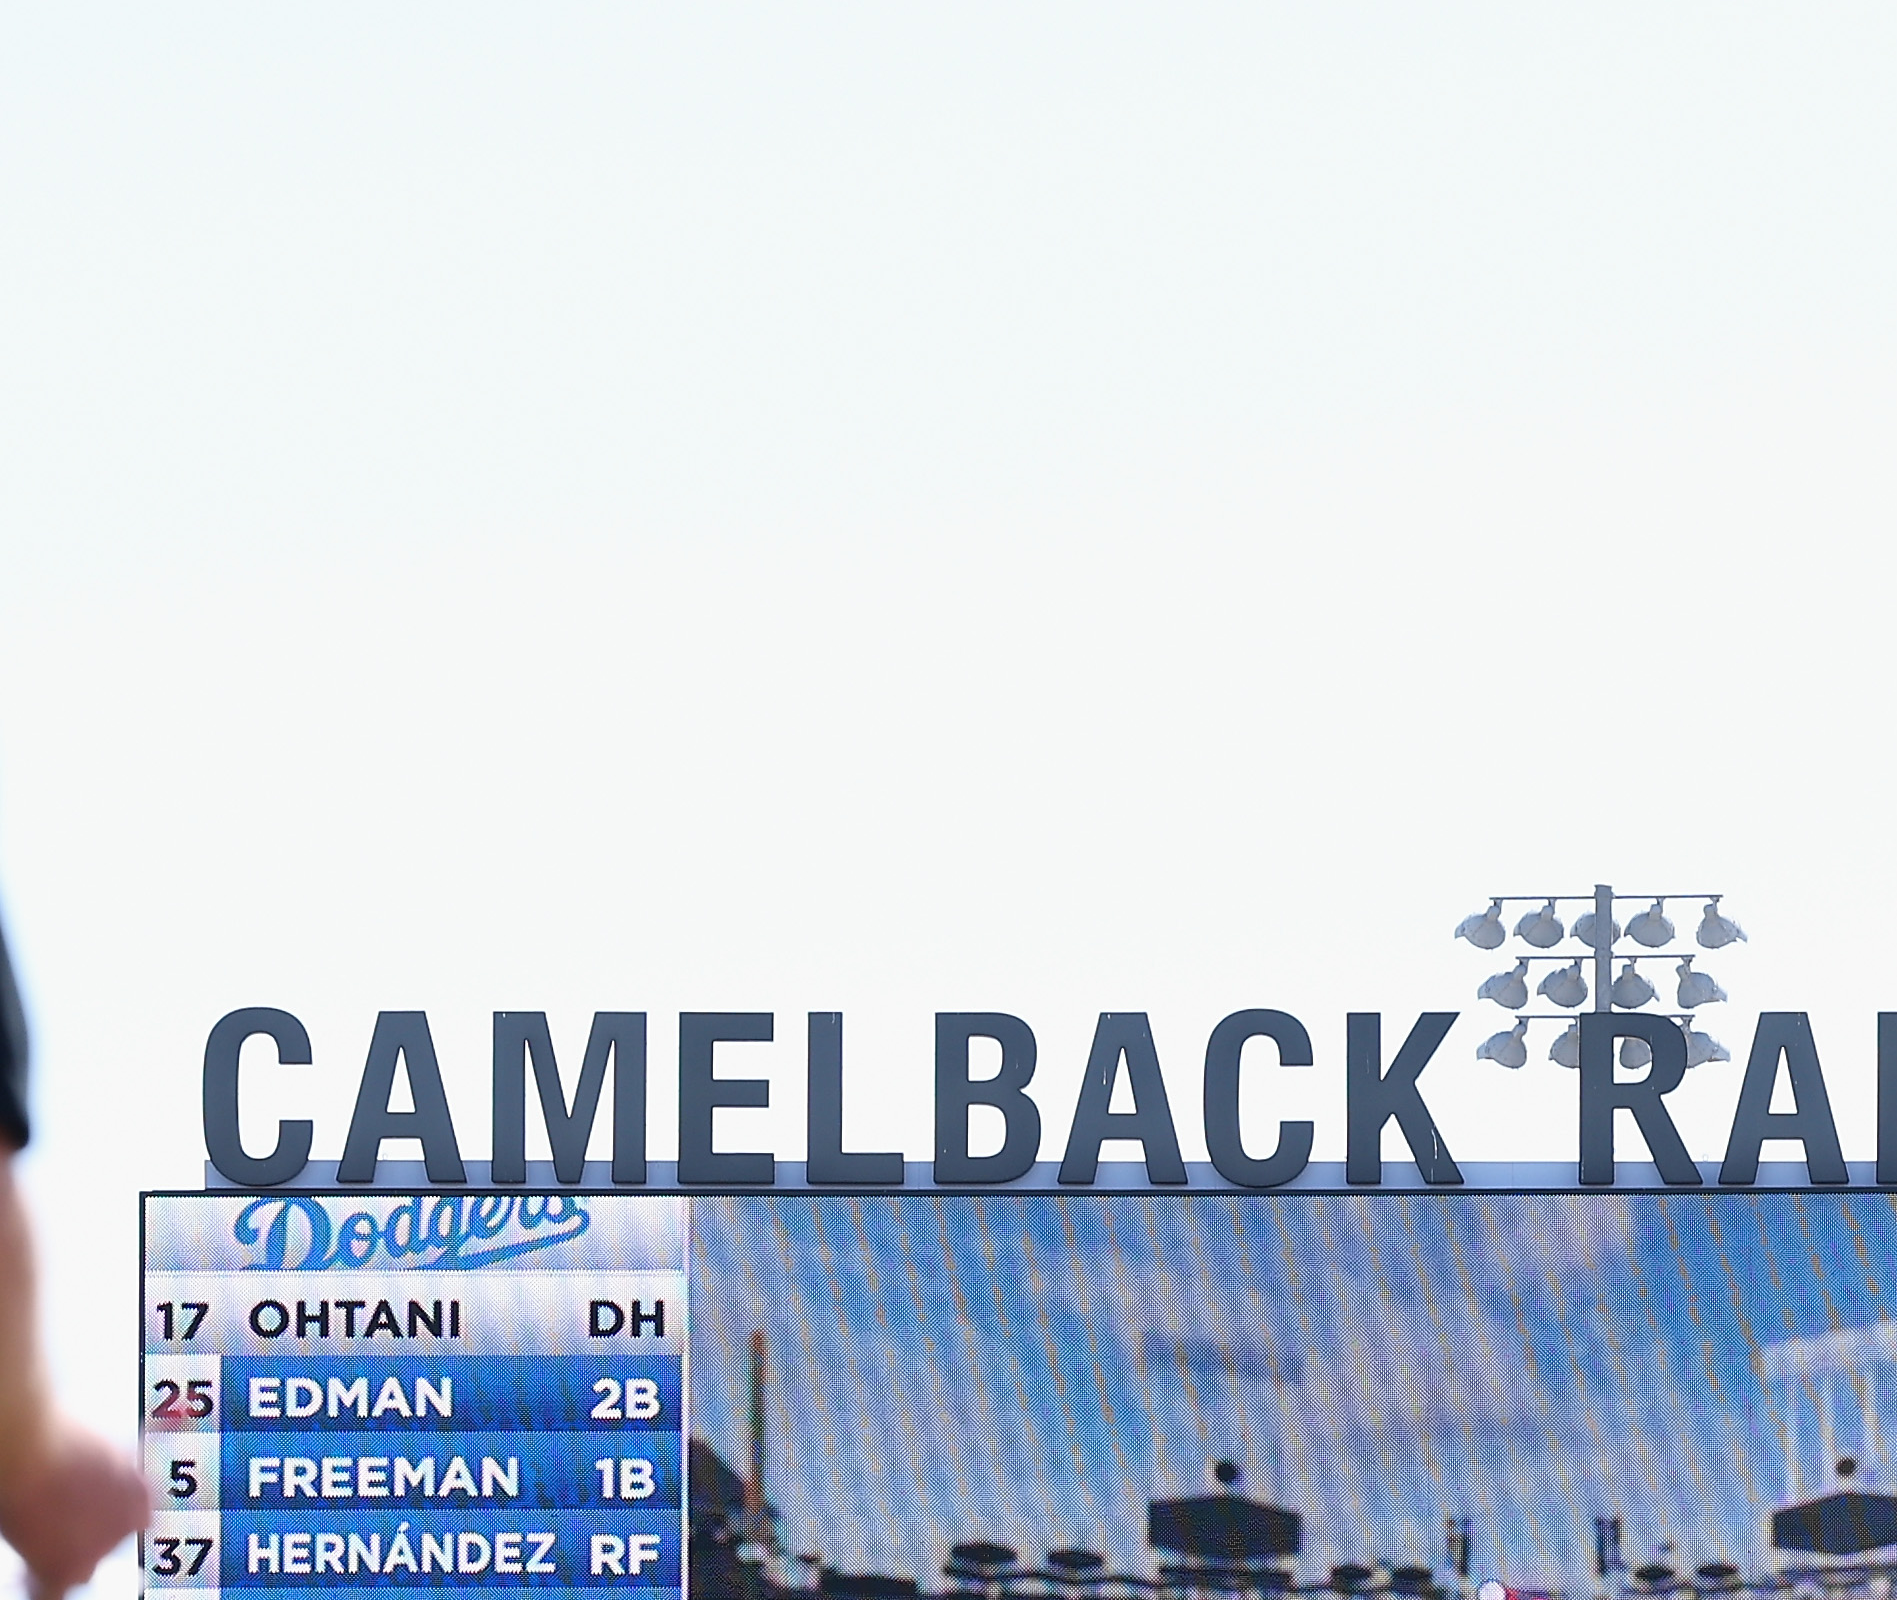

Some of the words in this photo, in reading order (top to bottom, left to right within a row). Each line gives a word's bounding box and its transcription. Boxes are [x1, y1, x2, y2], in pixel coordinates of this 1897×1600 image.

[202, 1007, 1463, 1186] CAMELBACK
[157, 1303, 208, 1341] 17
[249, 1300, 460, 1339] OHTANI
[589, 1300, 664, 1338] DH
[152, 1380, 214, 1419] 25
[250, 1377, 451, 1416] EDMAN
[592, 1378, 659, 1418] 2B
[170, 1460, 197, 1498] 5
[250, 1456, 518, 1496] FREEMAN
[596, 1458, 654, 1498] 1B
[153, 1538, 212, 1577] 37
[249, 1522, 555, 1573] HERNÁNDEZ
[591, 1534, 660, 1573] RF
